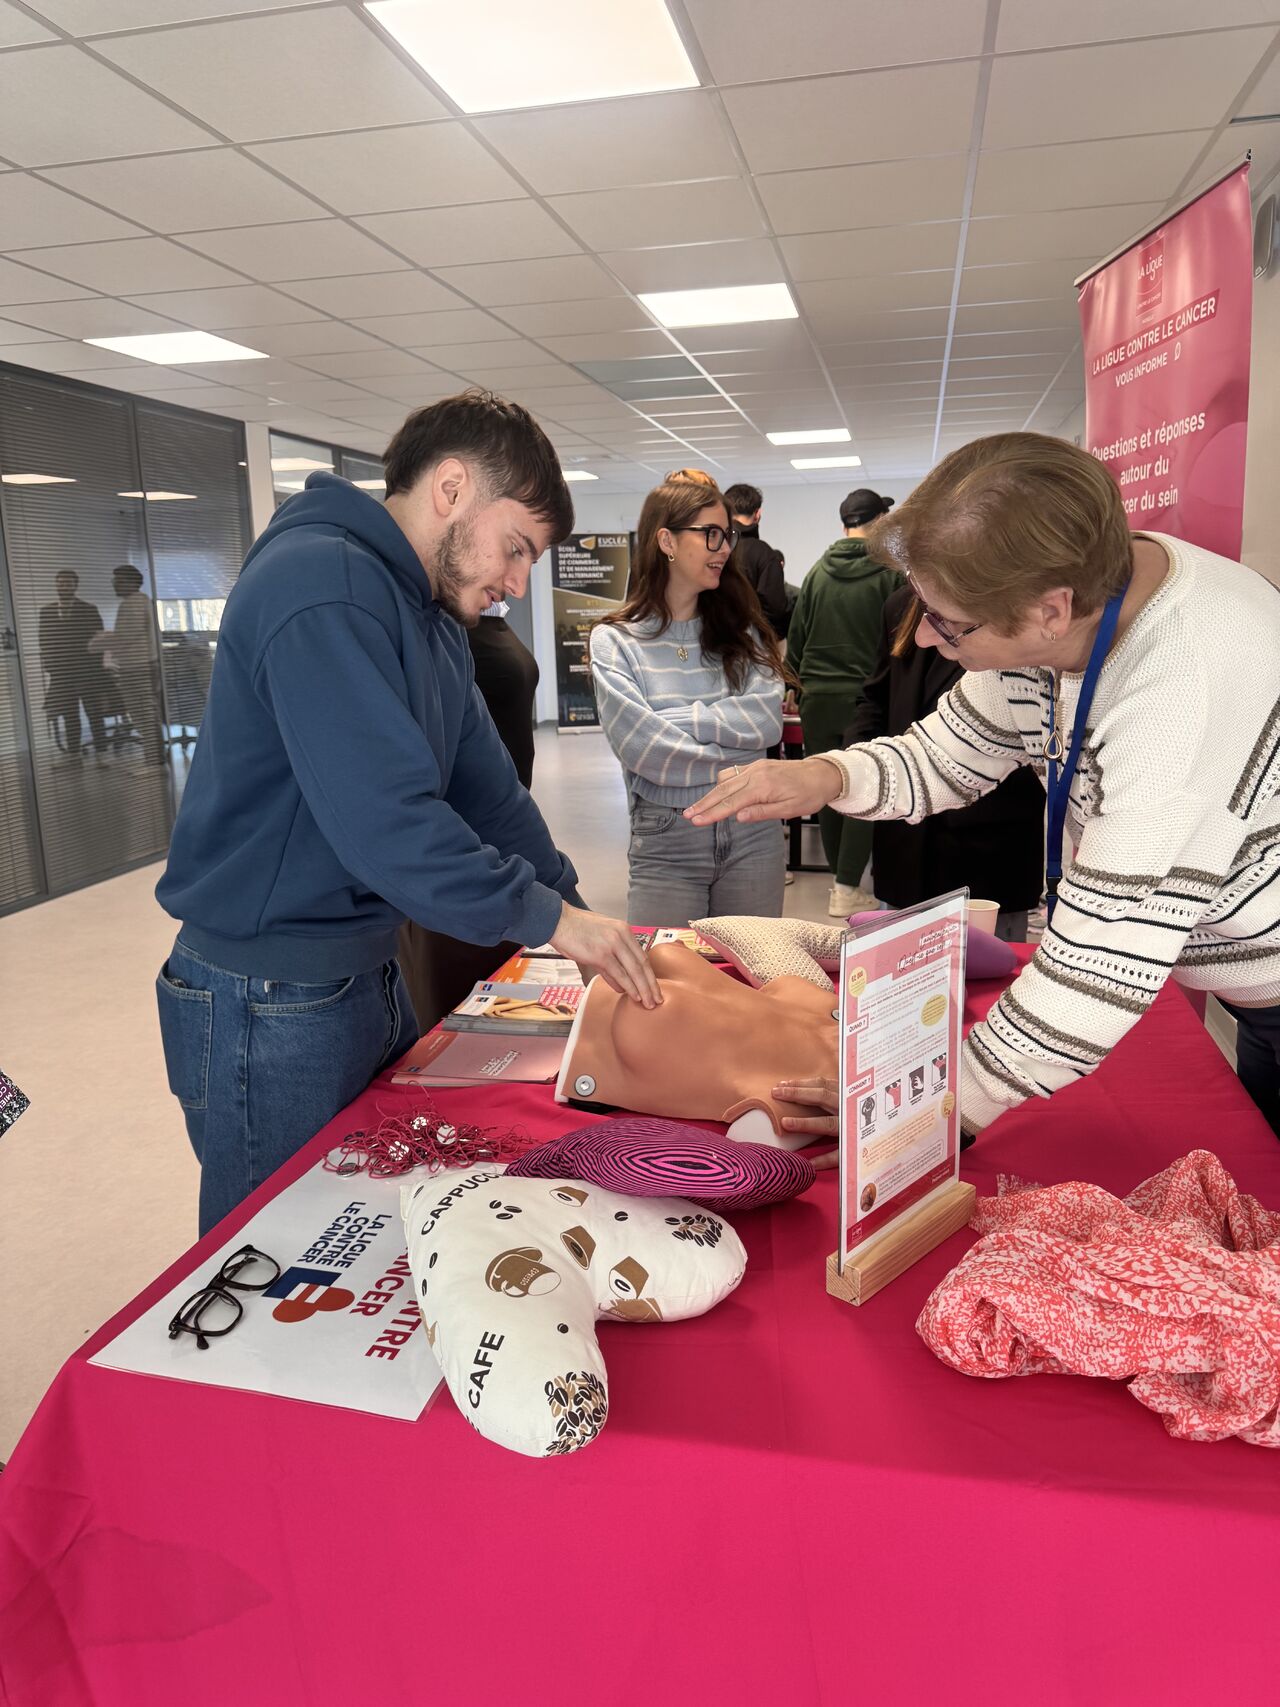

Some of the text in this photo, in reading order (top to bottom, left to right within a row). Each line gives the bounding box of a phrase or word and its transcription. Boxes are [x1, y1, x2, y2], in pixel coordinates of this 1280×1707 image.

[1093, 361, 1100, 375] LA
[1101, 347, 1125, 370] LIGUE
[1127, 327, 1159, 357] CONTRE
[1162, 320, 1173, 339] LE
[1175, 297, 1216, 331] CANCER
[1115, 352, 1168, 387] VOUS INFORME
[1092, 412, 1205, 462] Questions et réponses
[1120, 455, 1169, 486] autour du
[1122, 484, 1178, 514] cer du sein
[421, 1172, 501, 1235] CAPPUCC
[297, 1201, 366, 1264] LE CANCER
[315, 1216, 369, 1266] CONTRE
[334, 1214, 392, 1268] LA LIGUE
[365, 1300, 422, 1361] NTRE
[468, 1331, 505, 1409] CAFE
